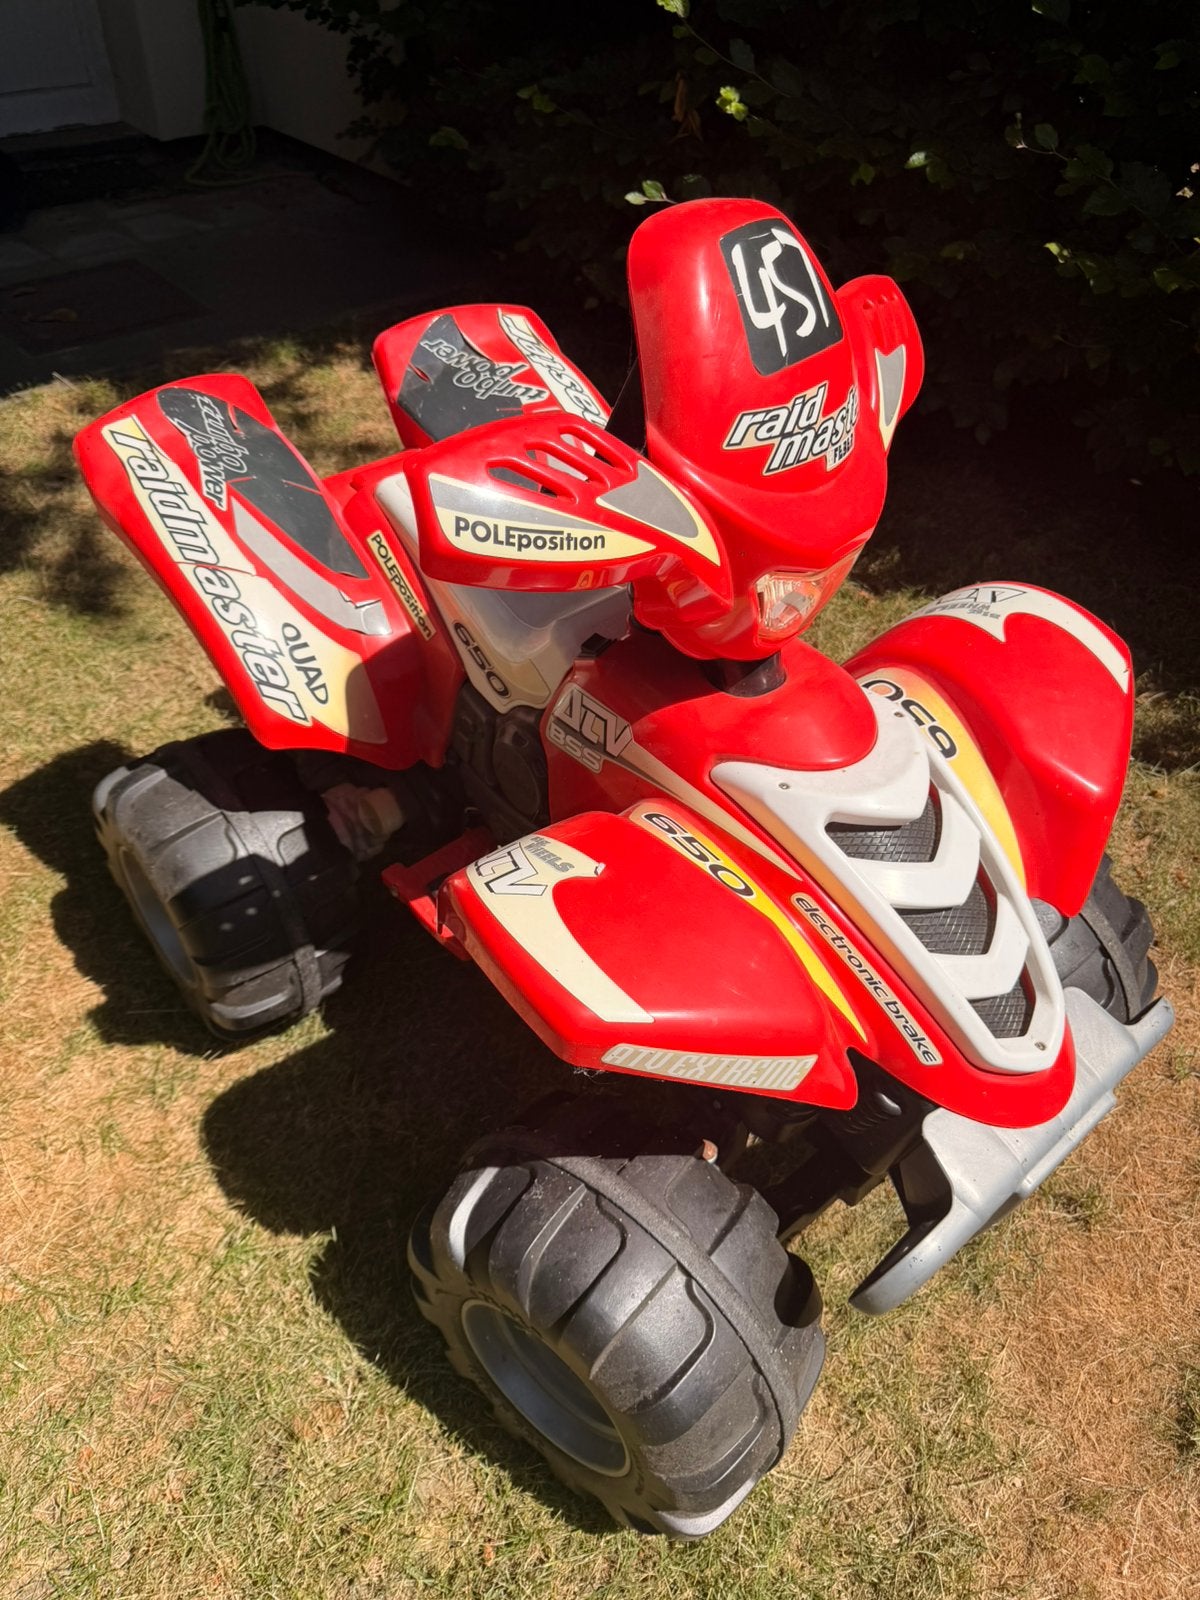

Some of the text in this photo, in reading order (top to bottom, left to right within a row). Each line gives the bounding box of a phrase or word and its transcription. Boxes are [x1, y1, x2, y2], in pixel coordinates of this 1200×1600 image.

[726, 383, 827, 447] raid
[455, 515, 607, 552] POLEposition
[110, 430, 308, 721] raidmaster
[372, 535, 433, 640] POLEposition
[281, 622, 330, 706] QUAD
[453, 621, 507, 698] 650
[550, 723, 601, 771] BSS
[644, 812, 756, 898] 650
[796, 895, 940, 1066] electronic brake
[605, 1046, 811, 1088] ATV EXTREME
